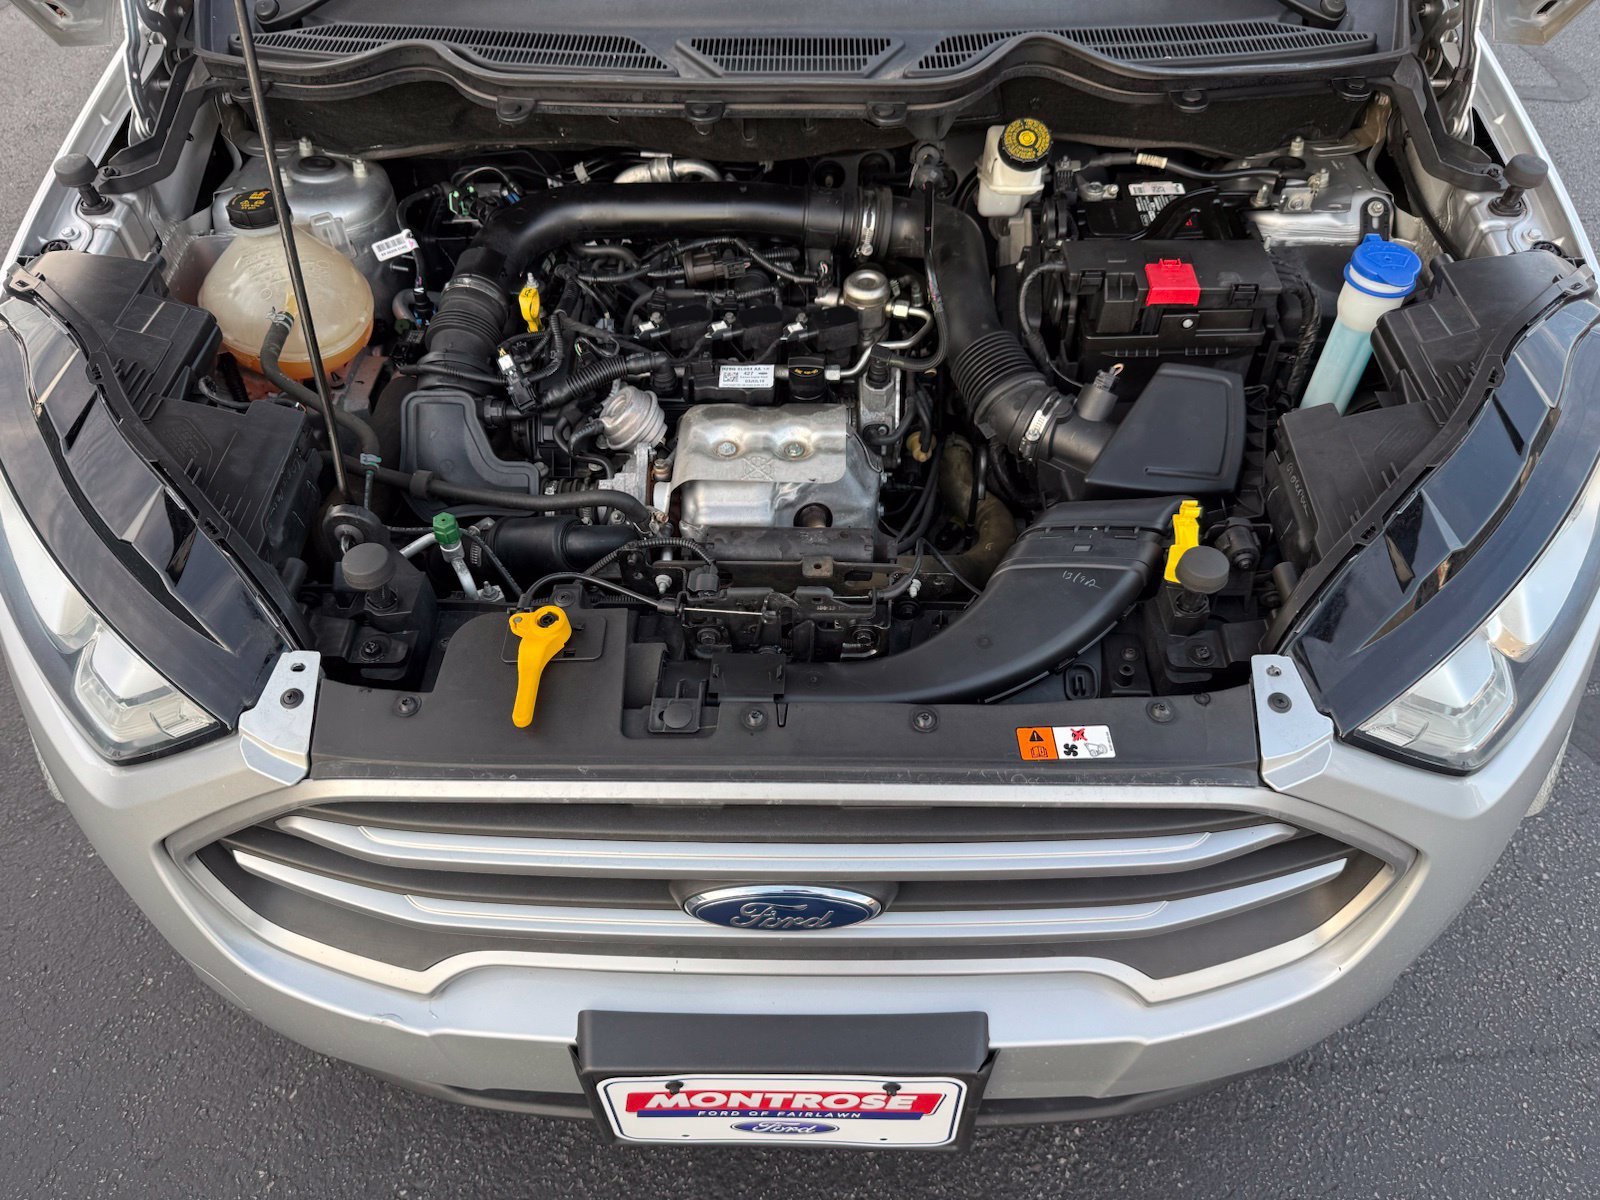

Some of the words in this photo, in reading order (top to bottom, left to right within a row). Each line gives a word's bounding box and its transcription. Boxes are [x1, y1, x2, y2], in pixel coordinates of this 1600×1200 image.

[730, 902, 835, 928] Ford
[644, 1091, 918, 1110] MONTROSE
[777, 1110, 861, 1119] FAIRLAWN
[751, 1121, 818, 1134] Ford
